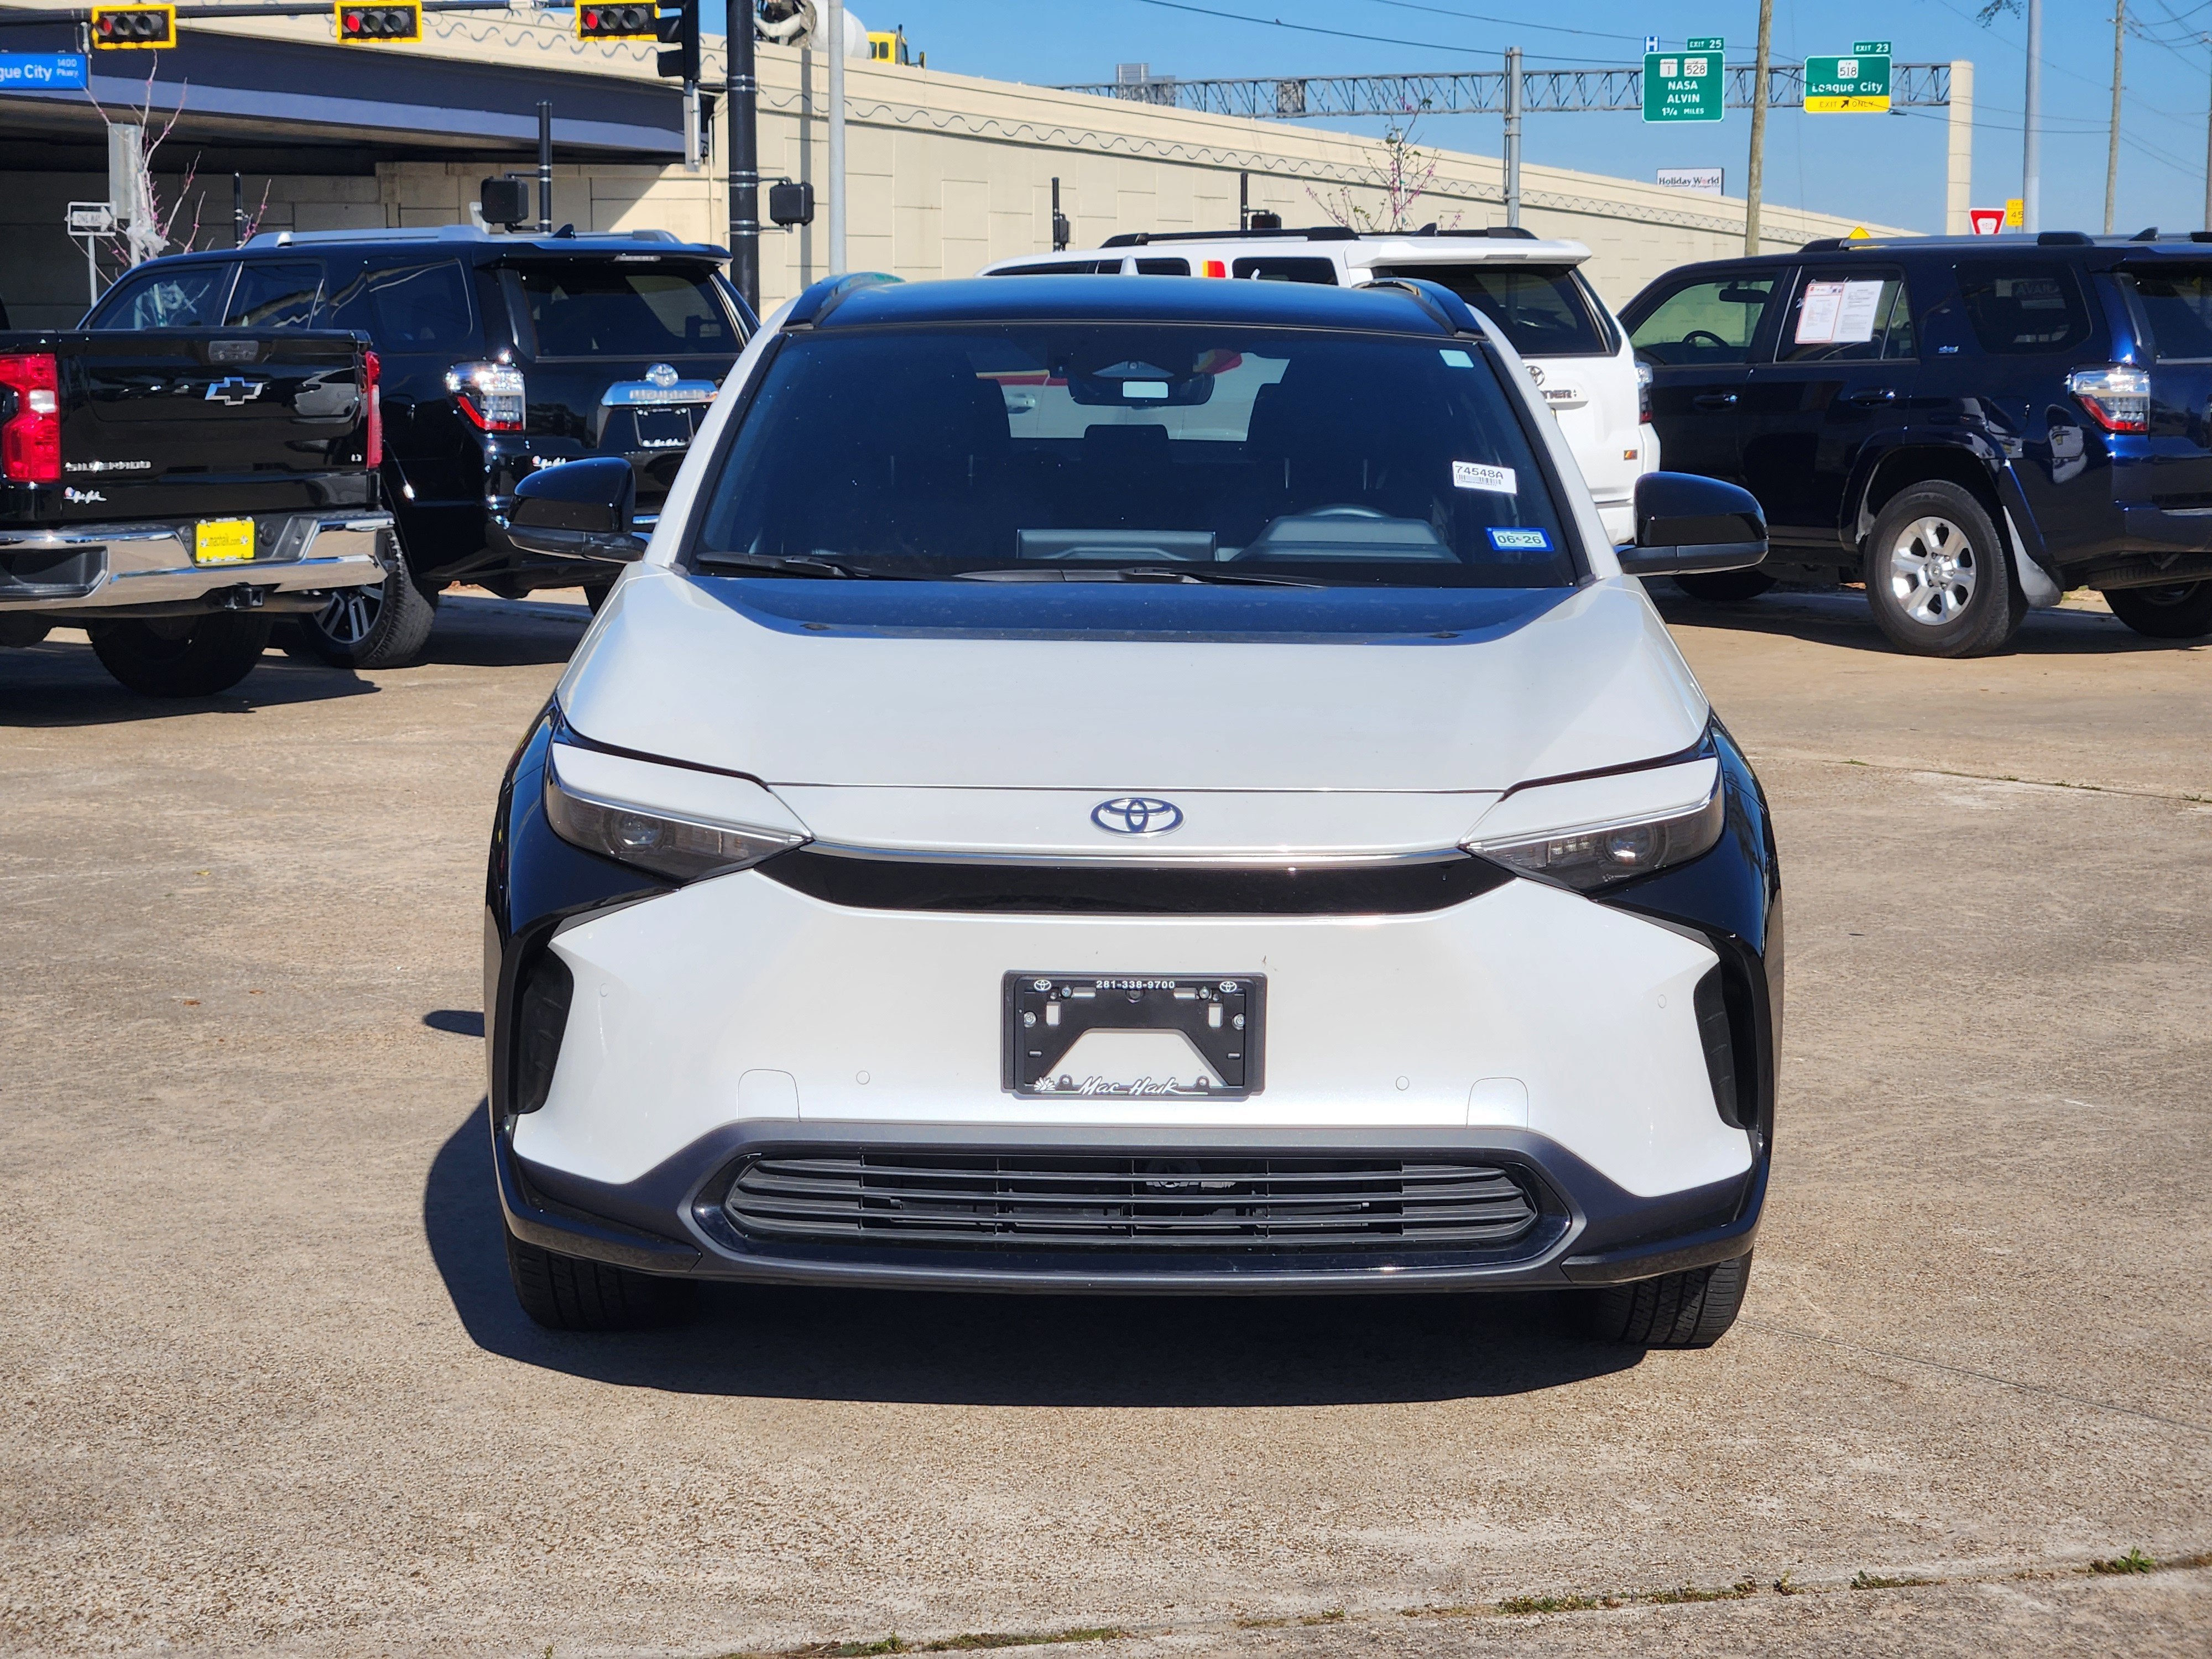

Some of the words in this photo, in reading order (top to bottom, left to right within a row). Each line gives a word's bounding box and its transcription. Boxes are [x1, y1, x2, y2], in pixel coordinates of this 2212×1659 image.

[1646, 36, 1658, 51] H
[1709, 40, 1721, 48] 25
[1876, 44, 1888, 53] 23
[57, 59, 77, 67] 1400
[24, 64, 53, 82] City
[1687, 65, 1705, 75] 528
[1839, 66, 1857, 76] 518
[1668, 81, 1698, 90] NASA
[1812, 83, 1854, 93] League
[1860, 81, 1883, 93] City
[1667, 93, 1700, 103] ALVIN
[1659, 176, 1691, 185] Holiday
[1455, 465, 1504, 479] 74548A
[1096, 980, 1175, 989] 281-338-9700
[1078, 1076, 1123, 1095] Mac
